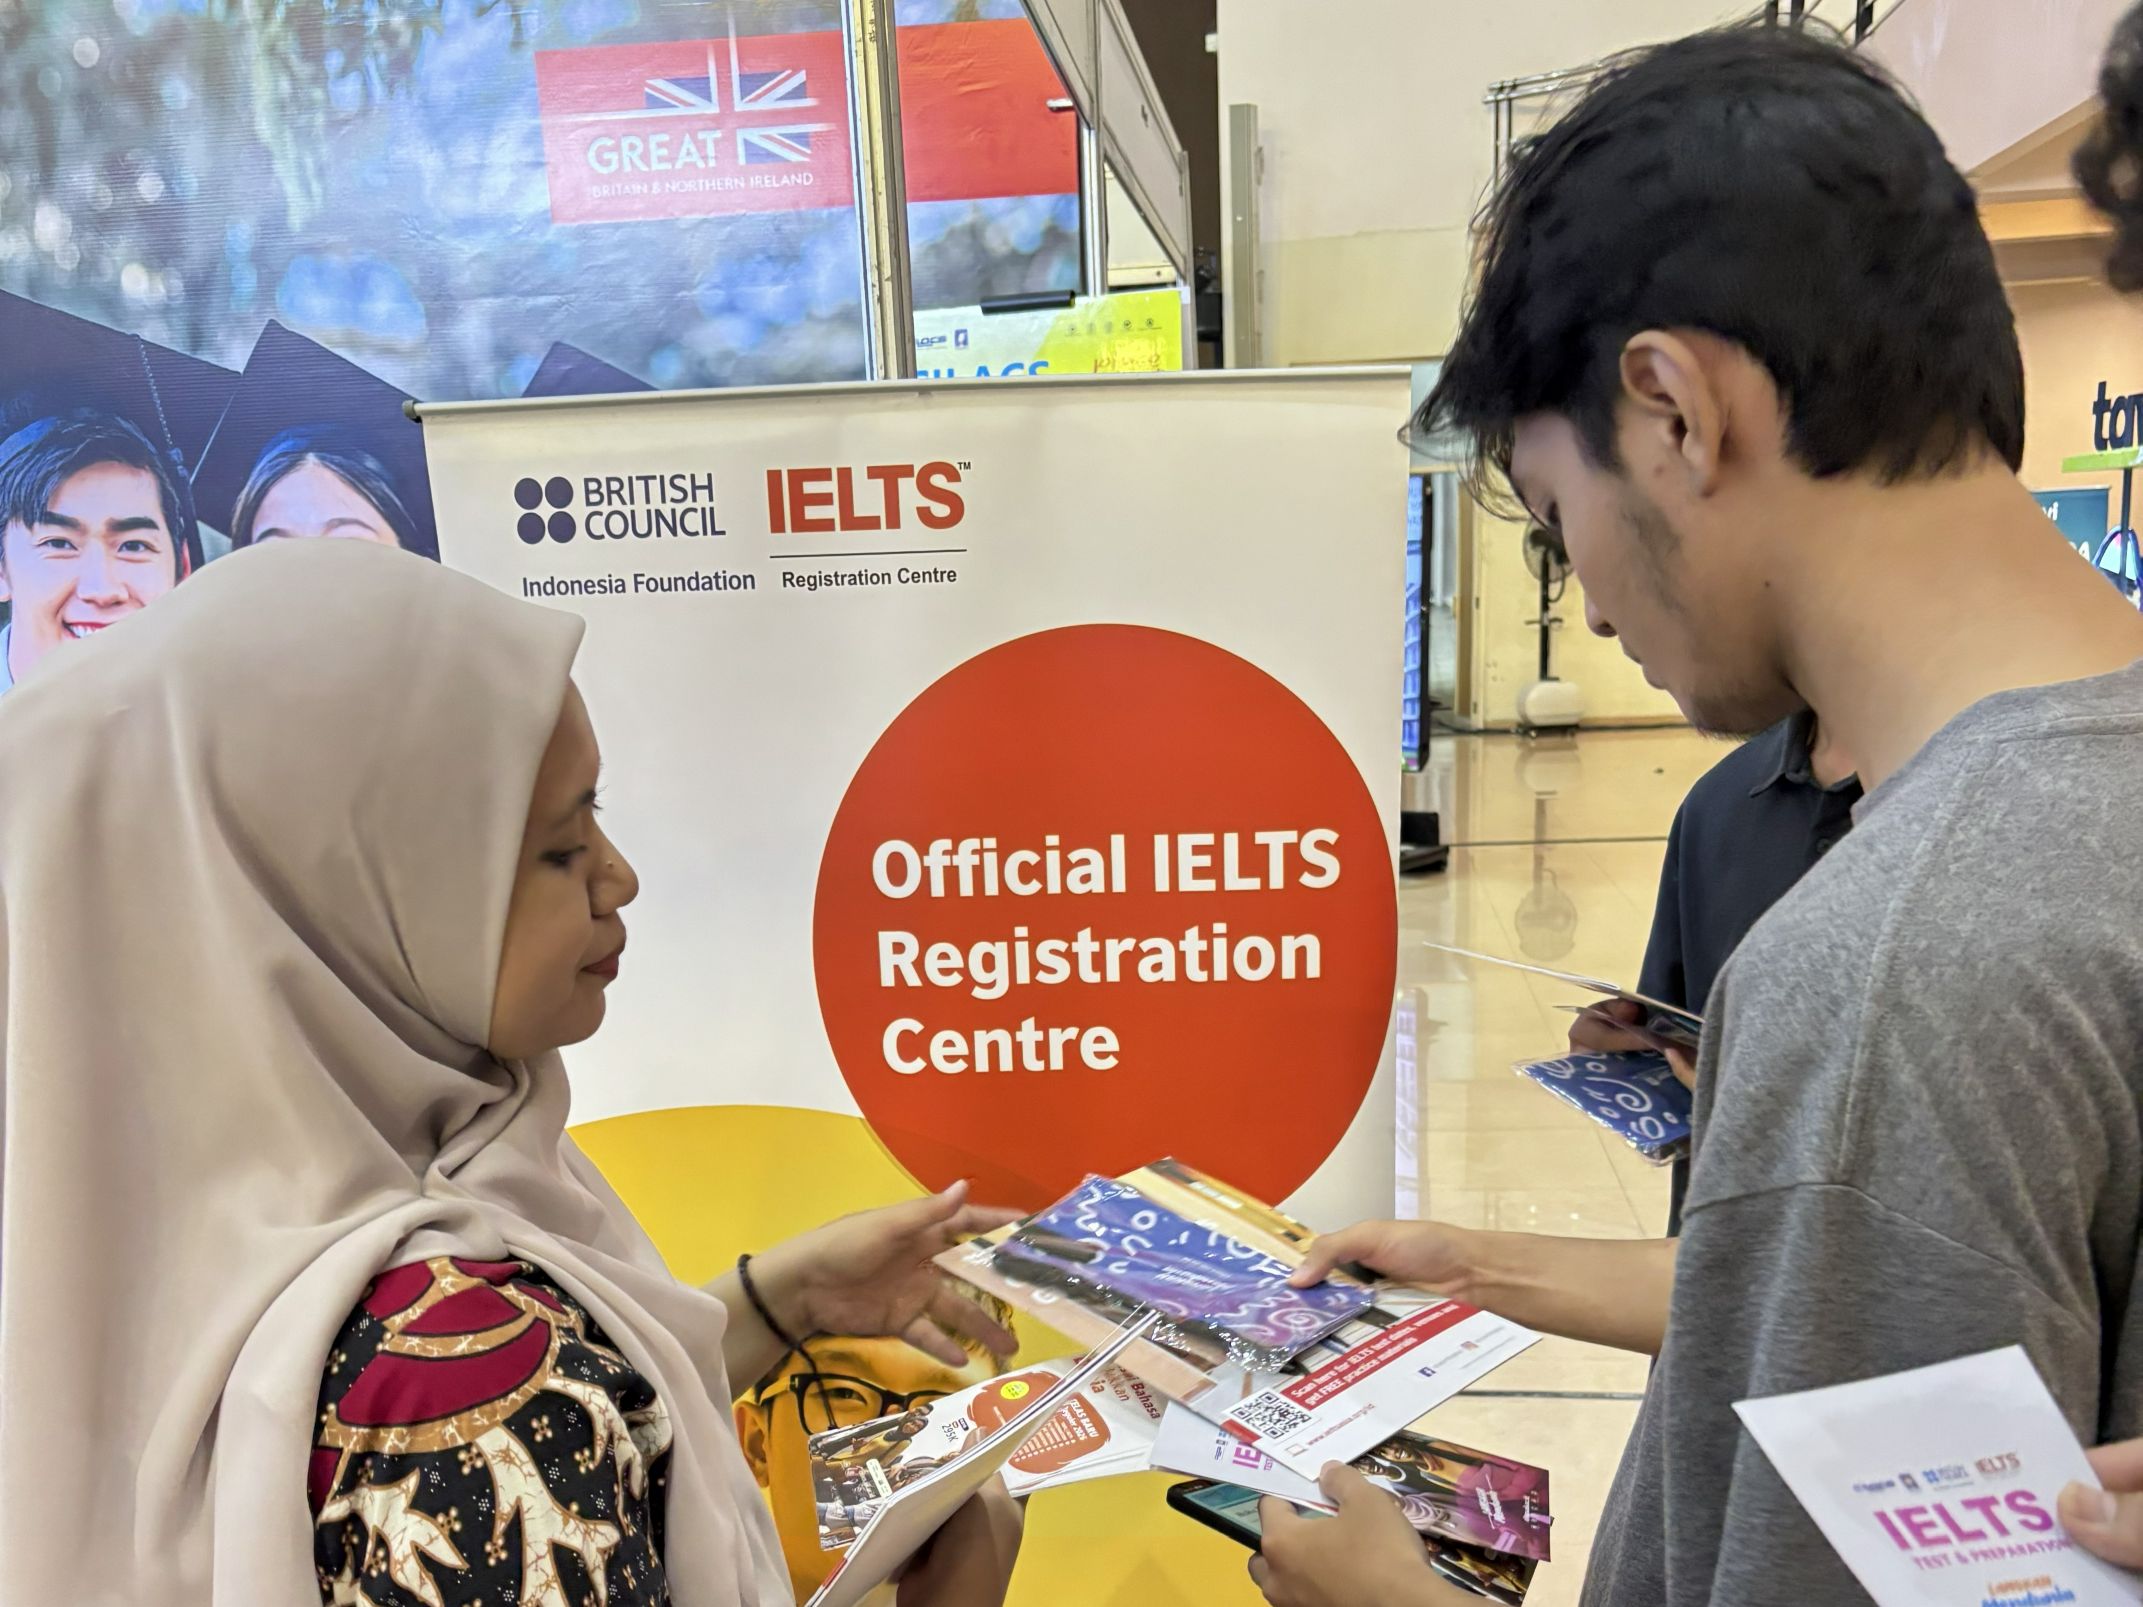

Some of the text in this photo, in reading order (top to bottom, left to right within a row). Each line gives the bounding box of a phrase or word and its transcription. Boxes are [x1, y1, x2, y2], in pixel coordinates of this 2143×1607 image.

[587, 130, 722, 174] GREAT
[592, 184, 648, 198] BRITAIN
[665, 176, 745, 192] NORTHERN
[750, 172, 814, 188] IRELAND
[583, 473, 715, 507] BRITISH
[766, 461, 965, 534] IELTS
[585, 507, 726, 541] COUNCIL
[522, 570, 756, 597] Indonesia Foundation
[782, 566, 957, 592] Registration Centre
[872, 828, 1341, 898] Official IELTS
[878, 922, 1321, 1000] Registration
[882, 1016, 1120, 1075] Centre
[1131, 1382, 1161, 1419] Bahasa
[1873, 1490, 2054, 1551] IELTS
[1913, 1552, 1951, 1570] TEST
